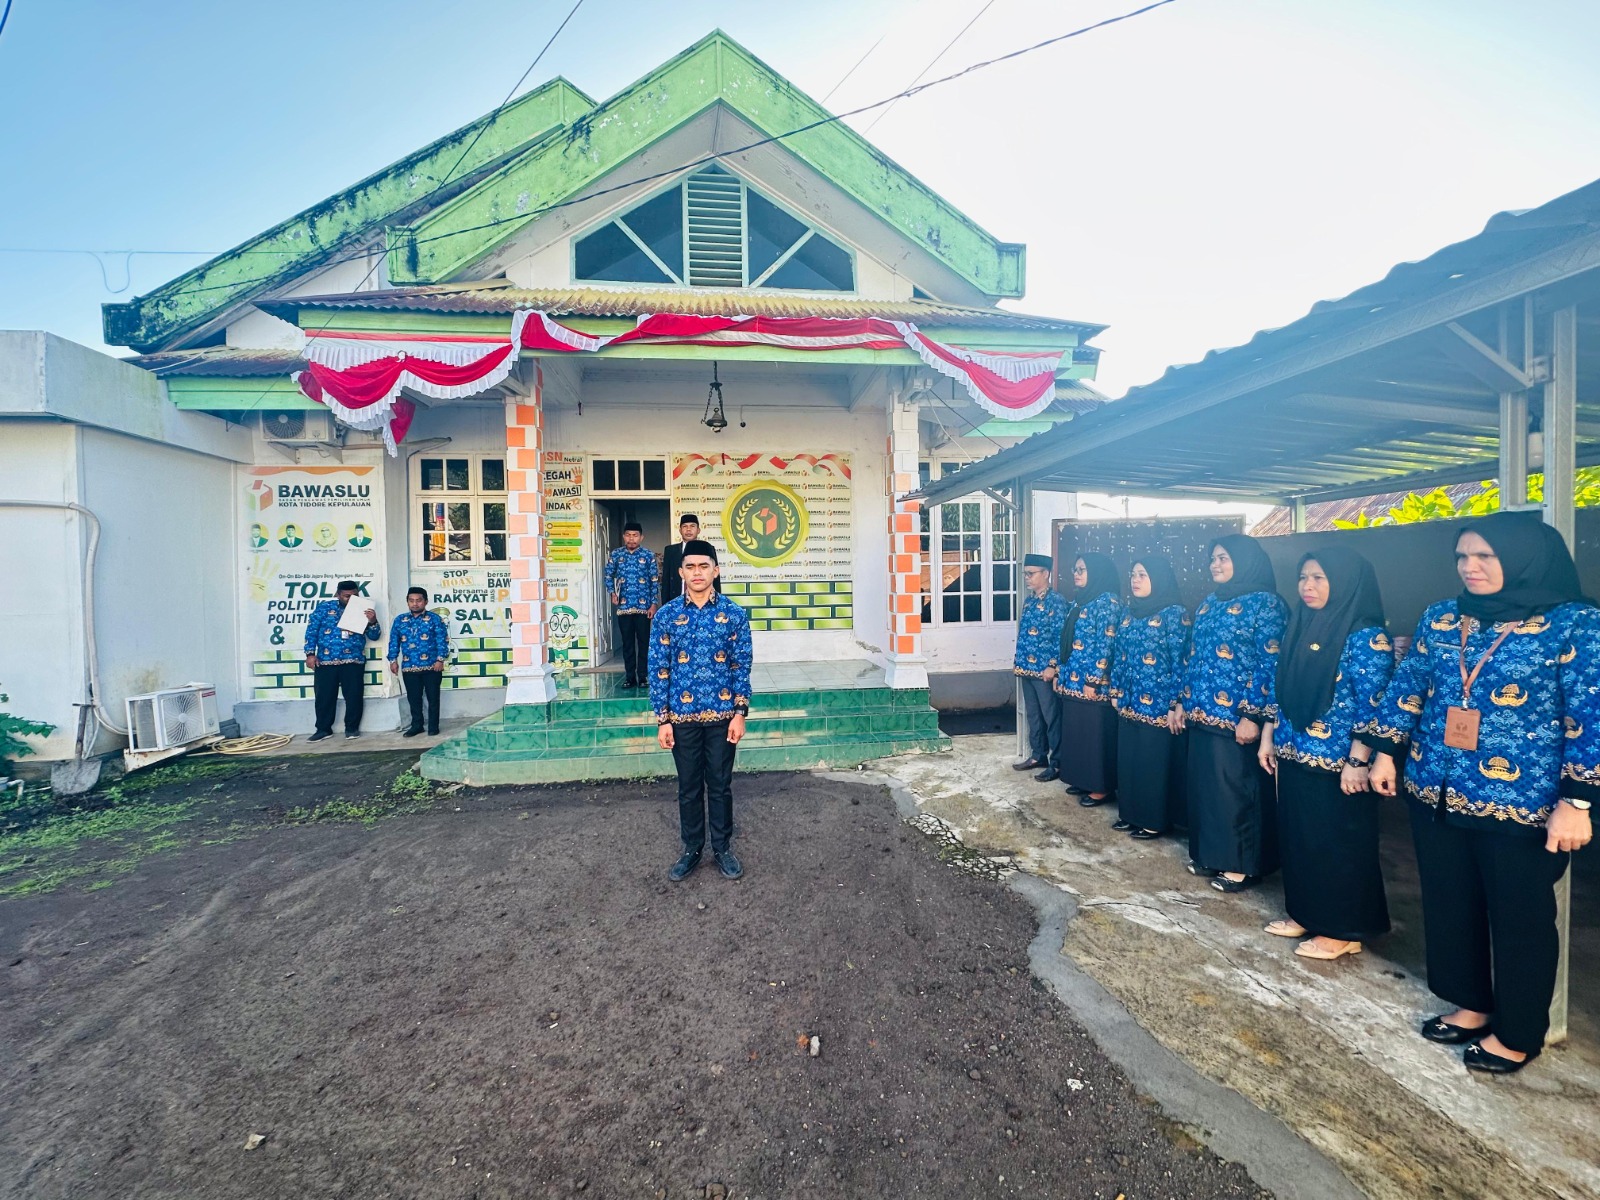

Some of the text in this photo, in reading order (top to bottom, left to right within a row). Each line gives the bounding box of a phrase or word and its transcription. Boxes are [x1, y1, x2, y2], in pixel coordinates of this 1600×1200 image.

[544, 471, 571, 480] EGAH
[278, 485, 370, 497] BAWASLU
[553, 487, 579, 496] AWASI
[444, 570, 468, 578] STOP
[442, 578, 472, 587] HOAX
[285, 581, 371, 598] TOLK
[434, 594, 488, 602] RAKYAT
[268, 614, 311, 624] POLITI
[270, 626, 285, 645] &
